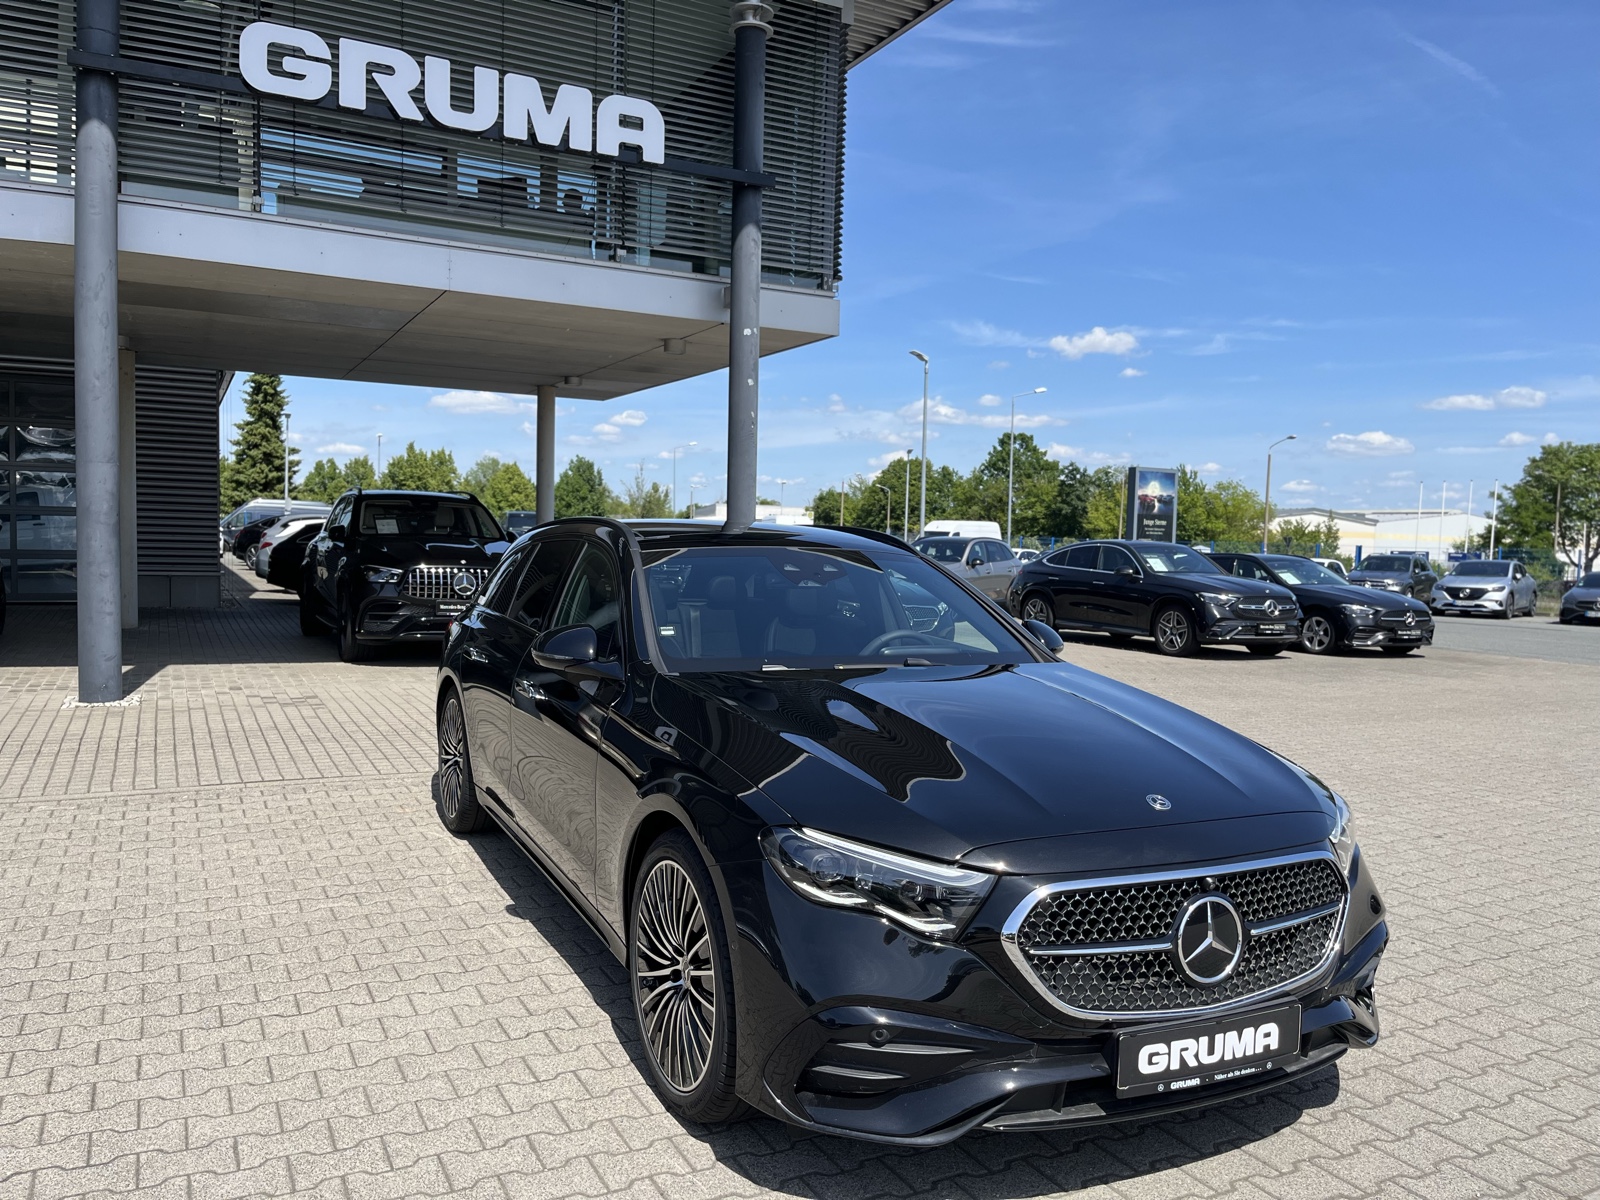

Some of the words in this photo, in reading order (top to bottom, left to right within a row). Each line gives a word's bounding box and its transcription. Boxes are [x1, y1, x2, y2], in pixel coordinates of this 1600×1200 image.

[239, 21, 666, 165] GRUMA
[1138, 1022, 1279, 1075] GRUMA
[1171, 1077, 1200, 1089] GRUMA
